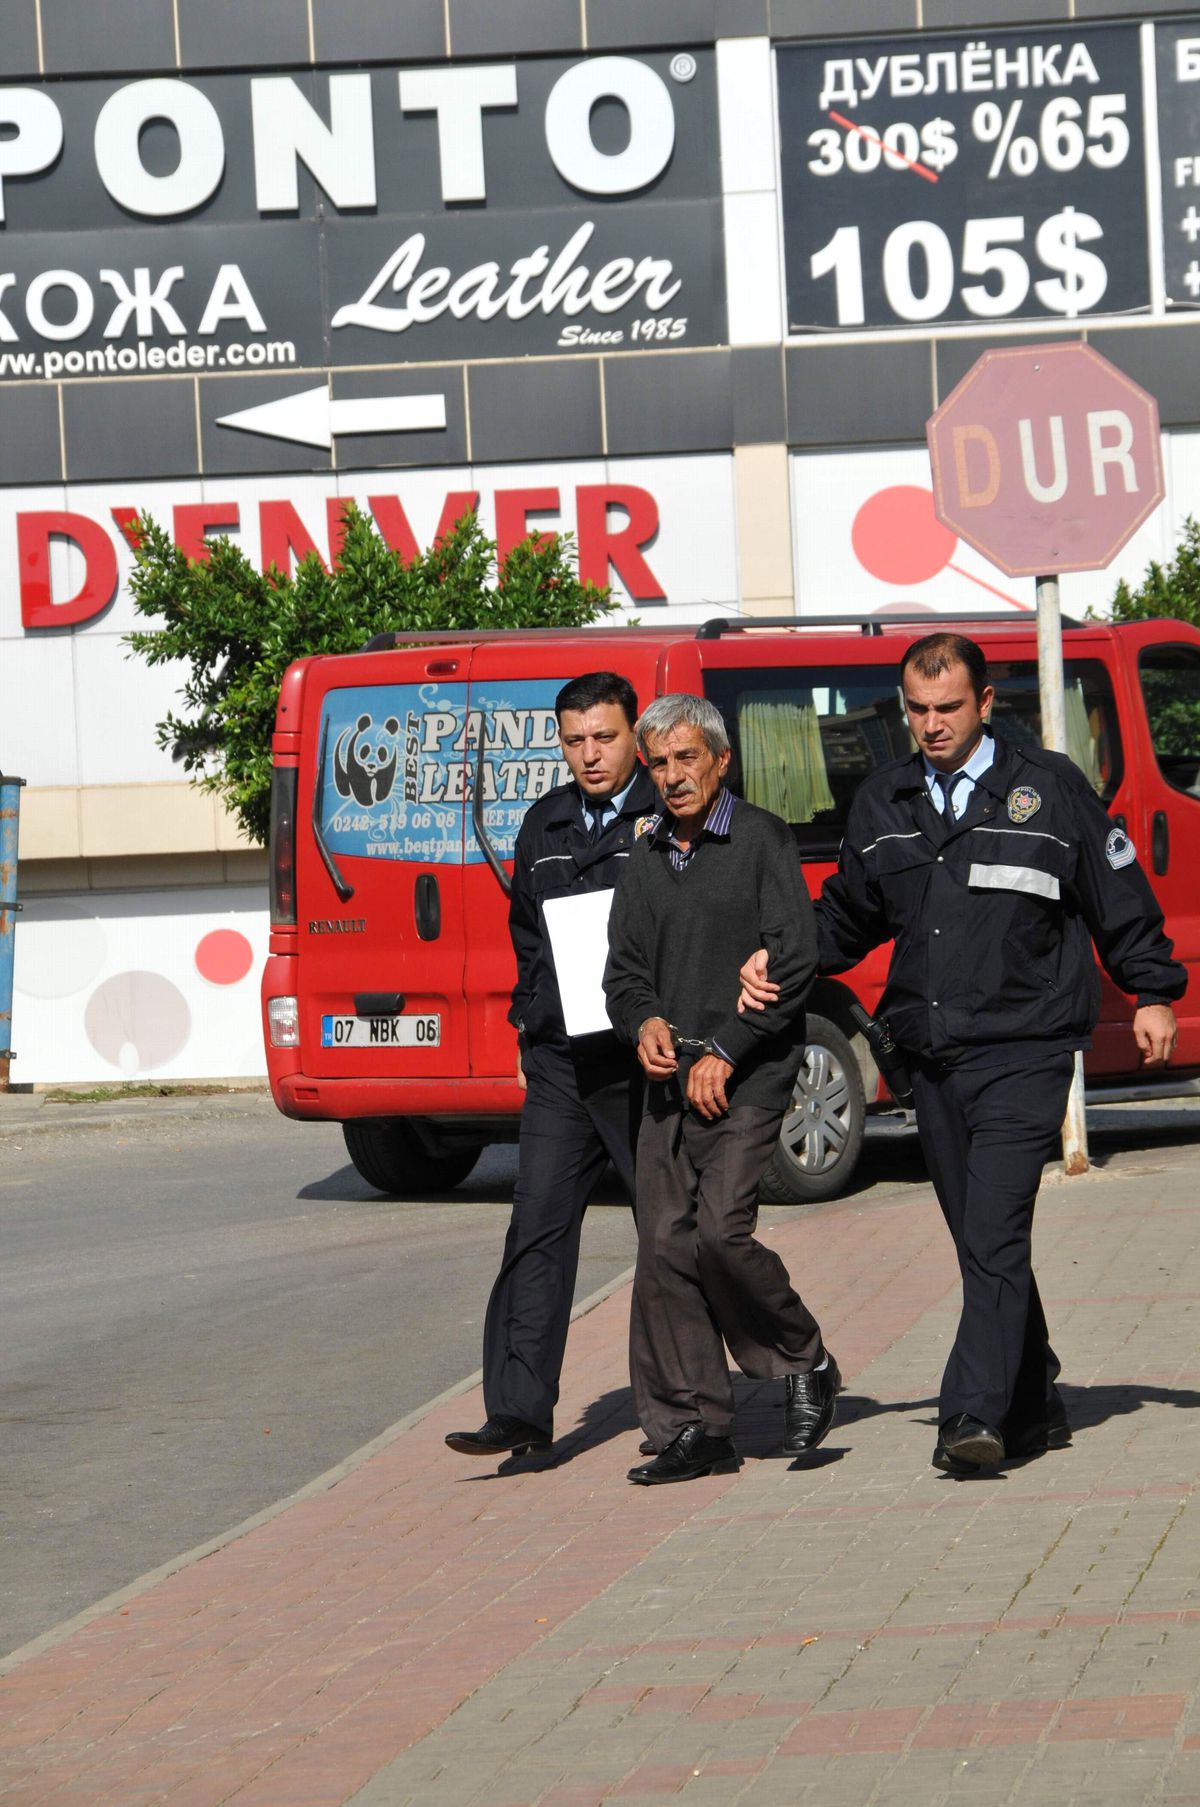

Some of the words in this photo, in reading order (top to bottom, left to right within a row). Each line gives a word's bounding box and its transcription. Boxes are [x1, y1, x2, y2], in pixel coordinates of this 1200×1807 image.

[818, 42, 1099, 109] ДУБЛЁНКА
[0, 56, 675, 221] PONTO
[807, 117, 959, 177] 300$
[972, 94, 1130, 179] %65
[332, 221, 682, 333] Leather
[809, 206, 1108, 325] 105$
[0, 340, 296, 378] w.pontoleder.com
[557, 324, 624, 347] Since
[631, 317, 688, 341] 1985
[951, 409, 1139, 509] DUR
[404, 711, 421, 804] BEST
[421, 708, 561, 752] PAND
[411, 812, 431, 829] 06
[309, 919, 366, 934] RENAULT
[334, 1020, 354, 1042] 07
[369, 1019, 400, 1042] NBK
[416, 1019, 437, 1042] 06
